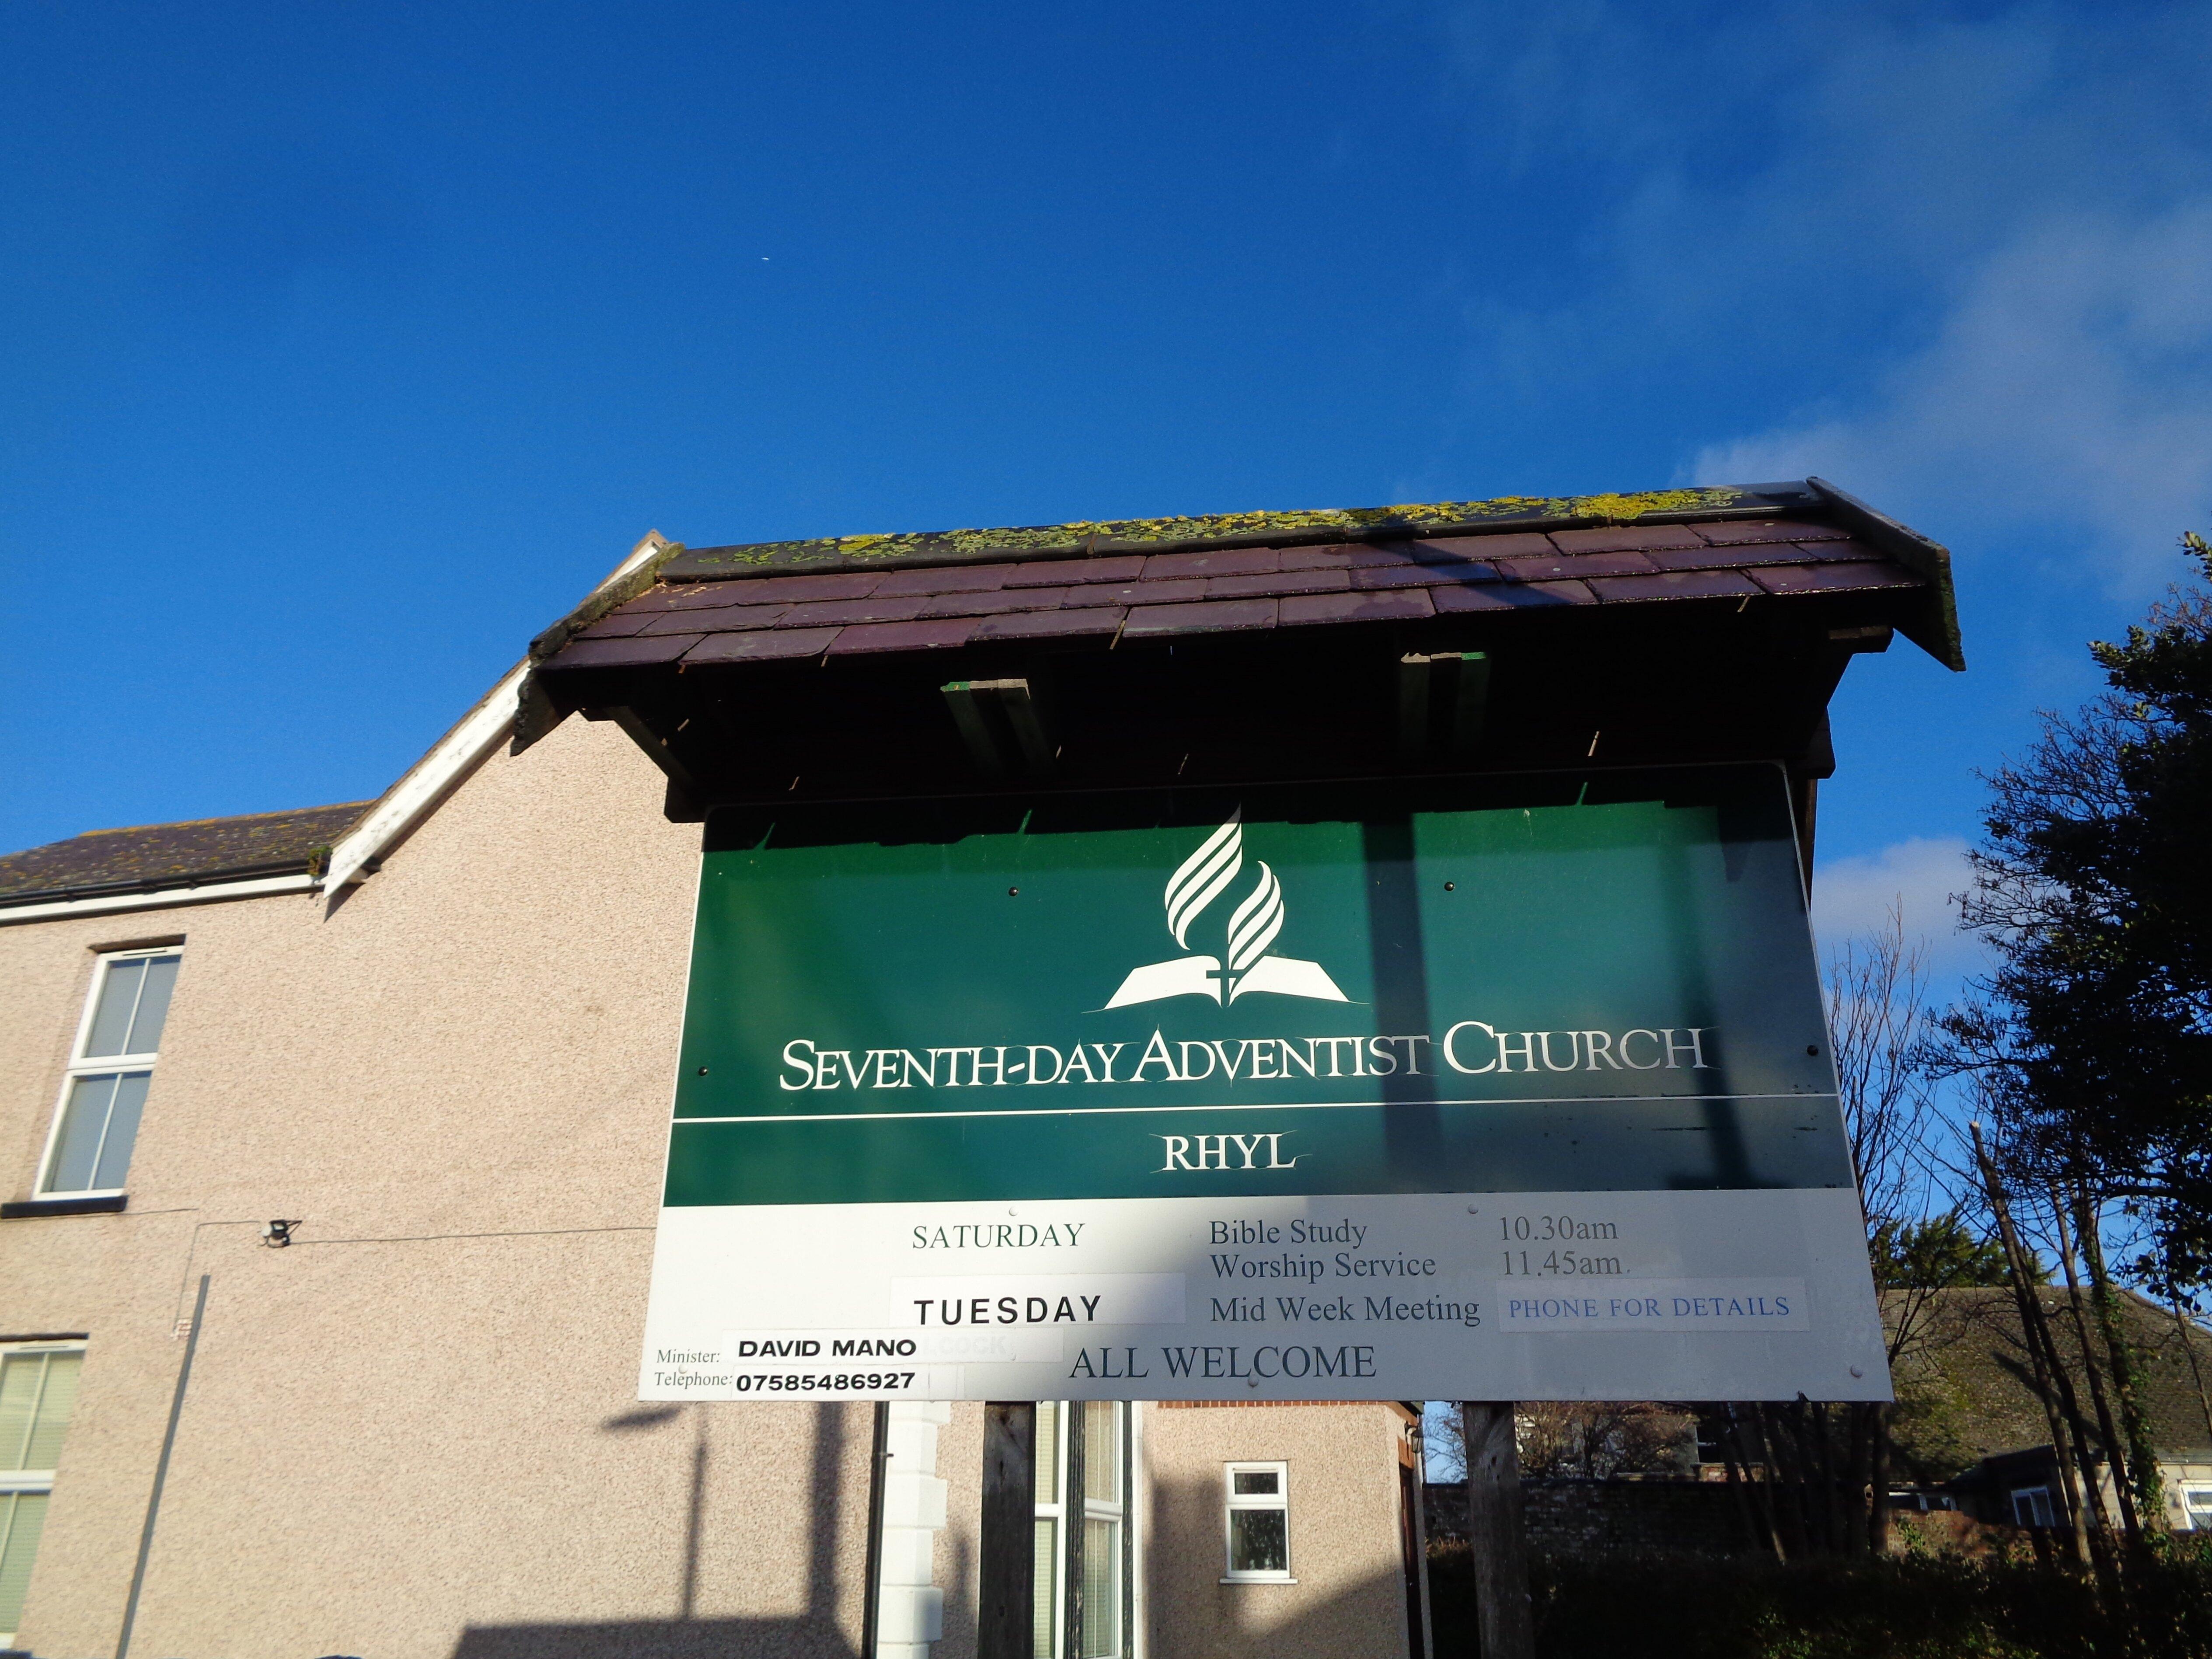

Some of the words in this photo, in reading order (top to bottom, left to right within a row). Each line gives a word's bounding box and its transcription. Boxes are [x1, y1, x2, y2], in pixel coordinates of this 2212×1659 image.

[779, 1039, 1124, 1091] SEVENTH-DAY
[1130, 1028, 1431, 1084] ADVENTIST
[1443, 1021, 1710, 1075] CHURCH
[1161, 1133, 1299, 1173] RHYL
[912, 1223, 1085, 1250] SATURDAY
[1209, 1219, 1281, 1245] Bible
[1289, 1217, 1367, 1249] Study
[1500, 1216, 1619, 1242] 10.30am
[1211, 1254, 1324, 1283] Worship
[1335, 1252, 1437, 1279] Service
[914, 1295, 1101, 1326] TUESDAY
[1210, 1295, 1267, 1321] Mid
[1276, 1295, 1354, 1321] Week
[1363, 1294, 1480, 1327] Meeting
[1509, 1300, 1599, 1318] PHONE
[1609, 1299, 1662, 1318] FOR
[1673, 1297, 1790, 1317] DETAILS
[656, 1349, 721, 1364] Minister:
[738, 1339, 822, 1359] DAVID
[831, 1339, 918, 1358] MANO
[1069, 1347, 1148, 1379] ALL
[1162, 1346, 1377, 1379] WELCOME
[654, 1371, 733, 1389] Telephone:
[736, 1372, 916, 1393] 07585486927
